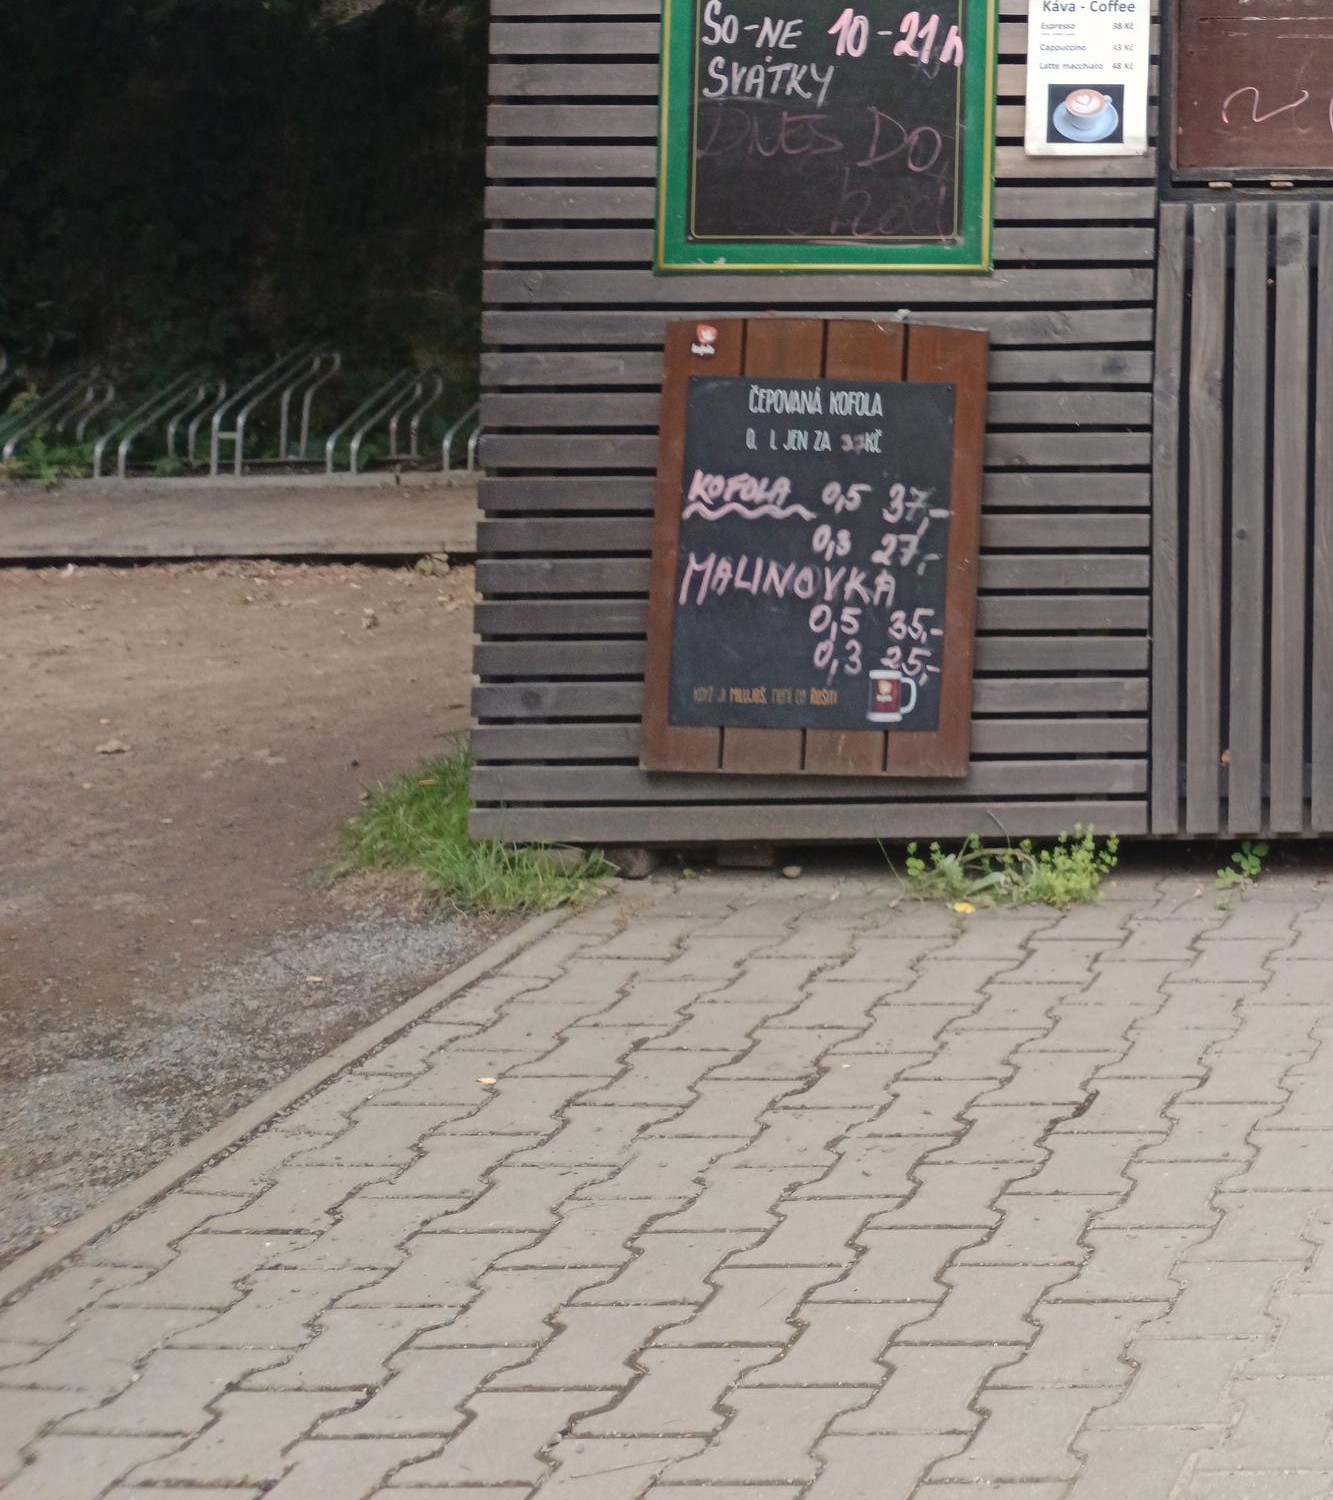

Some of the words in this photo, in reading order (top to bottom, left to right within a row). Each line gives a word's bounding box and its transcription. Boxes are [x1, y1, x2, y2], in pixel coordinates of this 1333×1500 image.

[1042, 0, 1076, 12] Káva
[1089, 0, 1136, 12] Coffee
[1040, 22, 1076, 31] Espresso
[1039, 62, 1060, 70] Latte
[1062, 62, 1104, 70] macchiato
[1040, 43, 1086, 53] Cappuccino
[702, 55, 834, 108] SVÁTKY
[749, 384, 823, 415] ČEPOVANÁ
[829, 390, 883, 417] KOFOLA
[782, 429, 809, 451] JEN
[813, 429, 832, 452] ZA
[688, 468, 792, 505] KOFOLA
[821, 481, 873, 515] 0,5
[811, 523, 852, 562] 0,3
[679, 551, 897, 607] MALINOVKA
[808, 603, 862, 642] 0,5
[813, 638, 862, 686] 0,3
